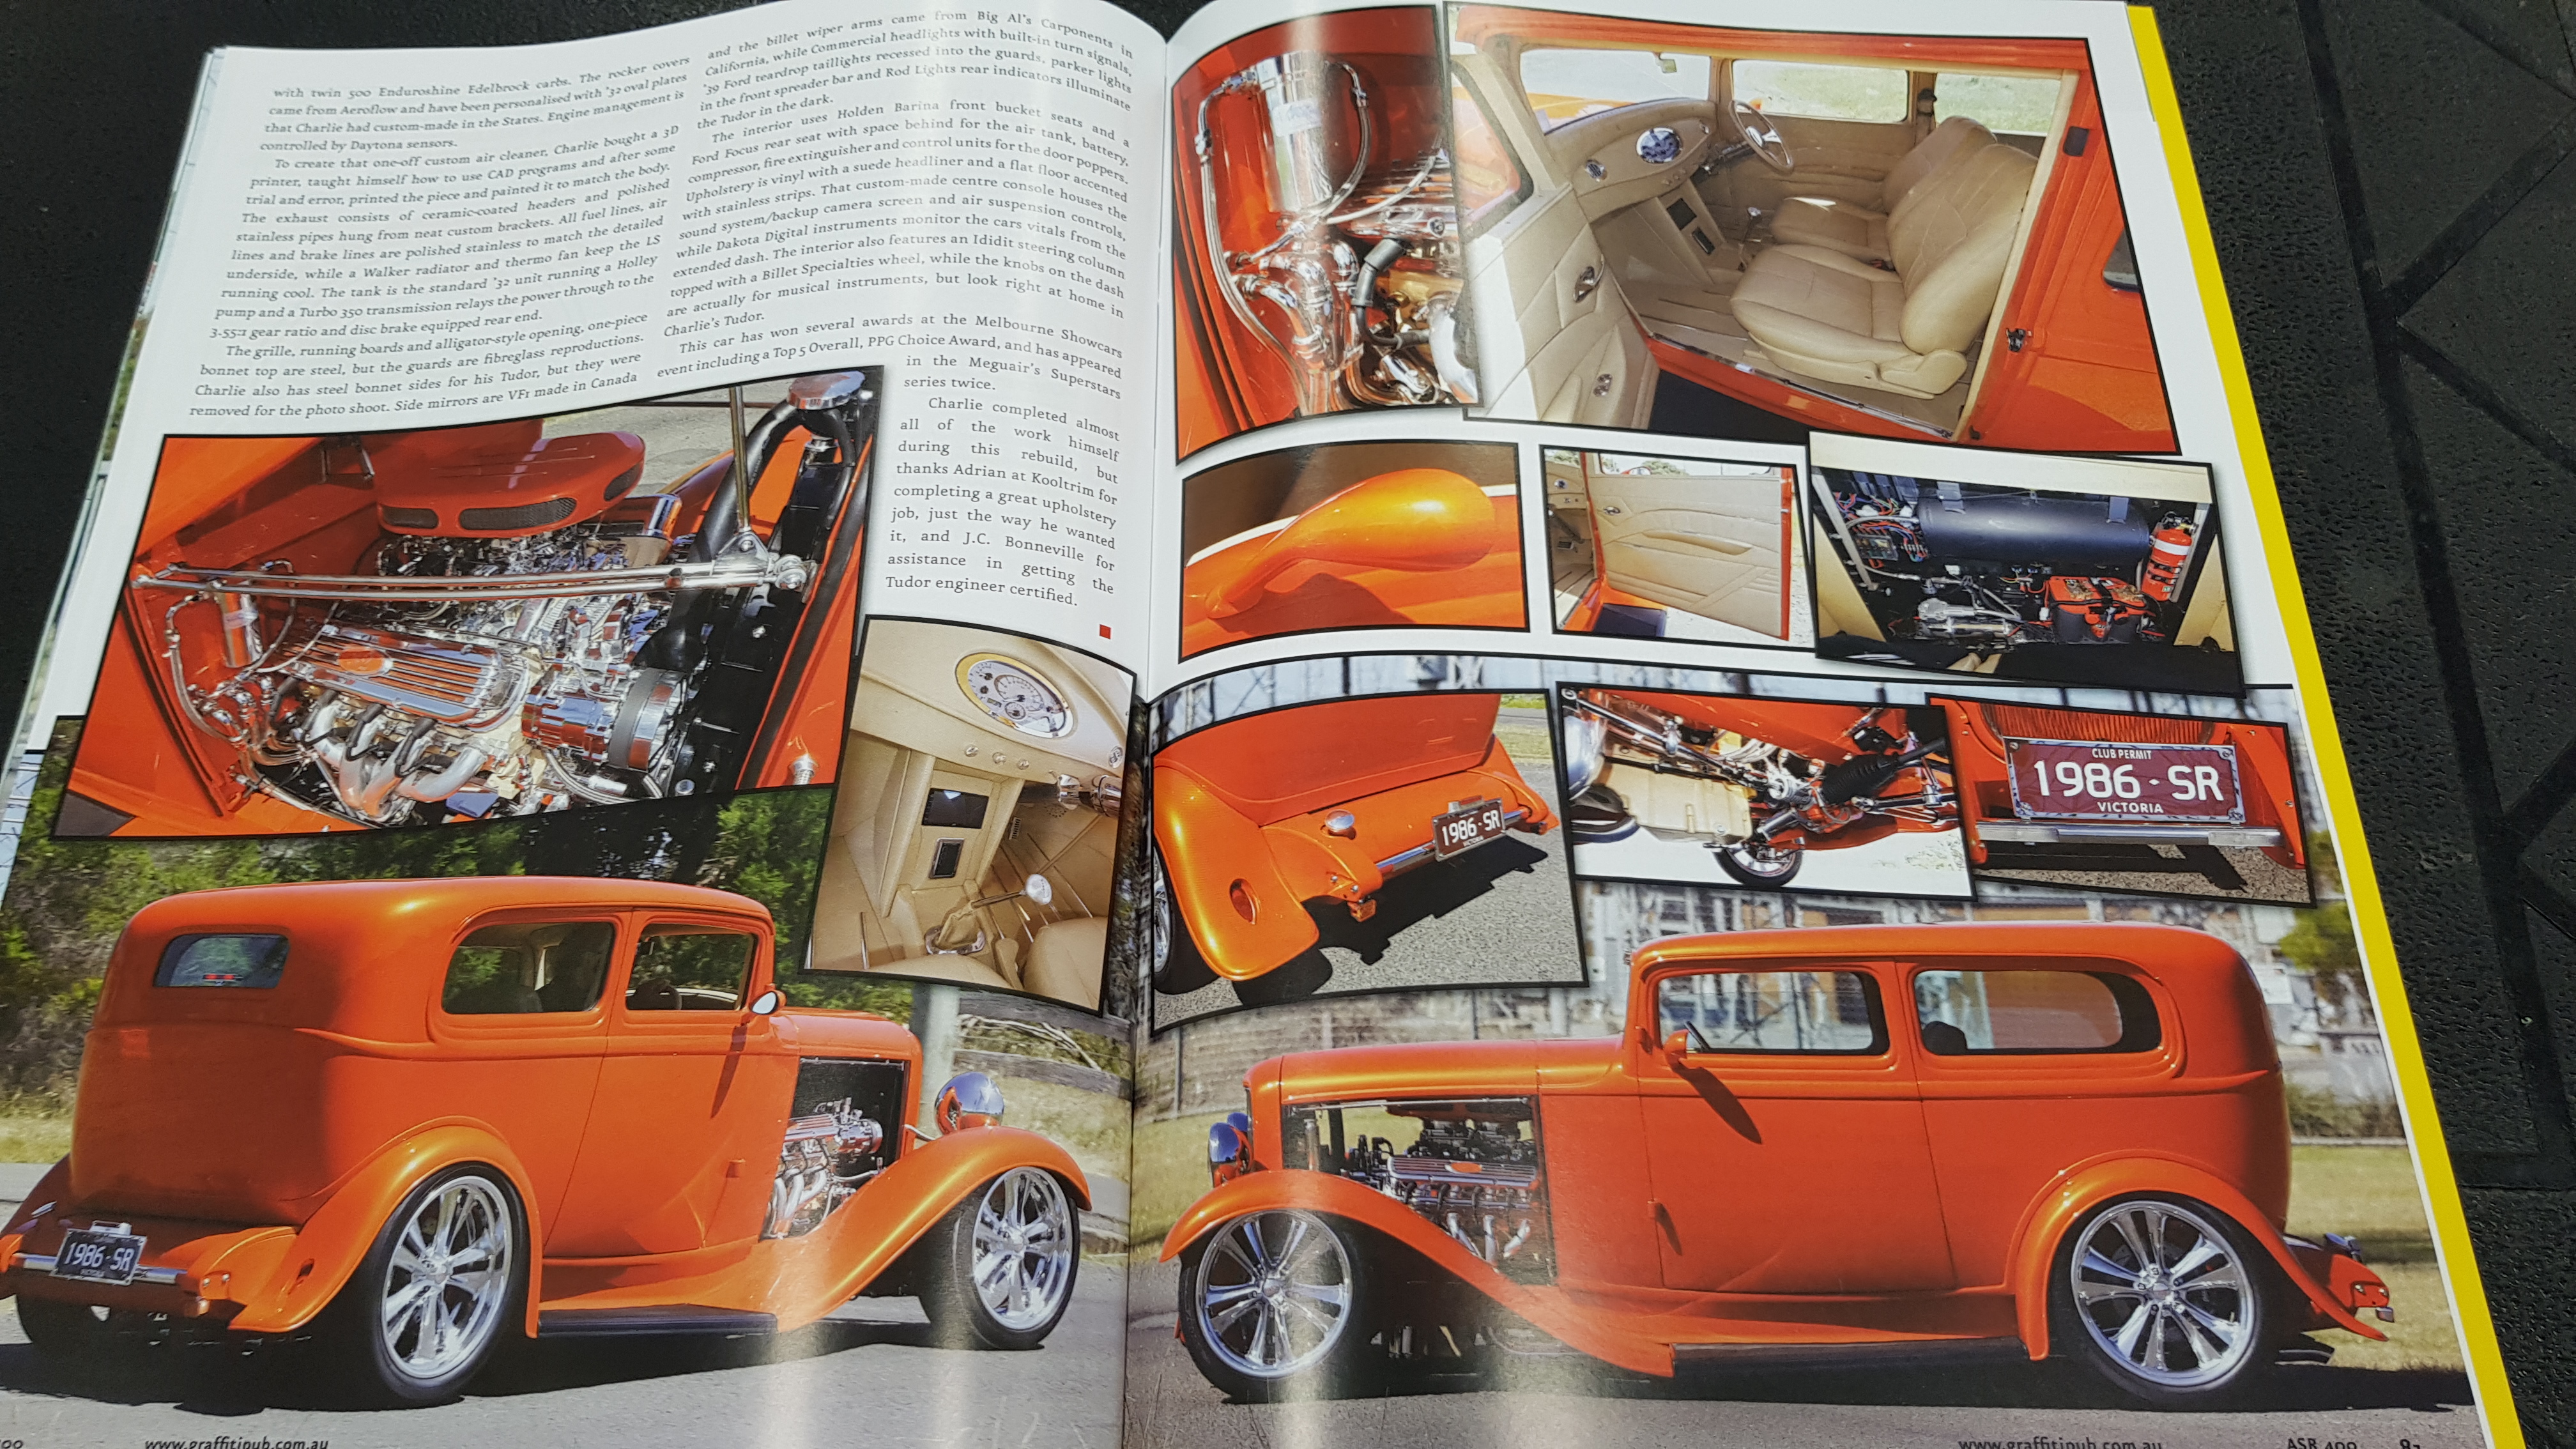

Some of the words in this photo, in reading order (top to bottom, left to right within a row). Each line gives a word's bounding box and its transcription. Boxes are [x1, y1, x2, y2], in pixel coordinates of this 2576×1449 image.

[697, 118, 717, 129] the
[720, 111, 756, 124] Tudor
[760, 106, 772, 116] in
[776, 101, 797, 112] the
[799, 93, 834, 108] dark.
[241, 213, 266, 223] The
[275, 213, 328, 224] exhaust
[337, 212, 390, 223] consists
[399, 210, 415, 221] of
[422, 202, 518, 220] ceramic-coated
[527, 197, 576, 211] headers
[584, 189, 609, 203] and
[617, 178, 670, 201] polished
[305, 268, 343, 279] while
[364, 266, 411, 277] Walker
[415, 264, 470, 275] radiator
[474, 258, 500, 271] and
[505, 255, 553, 268] thermo
[557, 250, 578, 261] fan
[585, 245, 614, 257] keep
[620, 240, 640, 251] the
[646, 234, 661, 246] LS
[676, 243, 712, 259] while
[716, 236, 760, 251] Dakota
[765, 224, 808, 243] Digital
[813, 218, 897, 234] instruments
[903, 213, 961, 224] monitor
[965, 213, 989, 226] the
[993, 218, 1022, 229] cars
[1027, 222, 1065, 238] vitals
[1070, 229, 1102, 250] from
[1106, 244, 1126, 260] the
[666, 307, 687, 317] are
[693, 294, 746, 312] actually
[751, 290, 772, 302] for
[778, 280, 830, 298] musical
[837, 275, 928, 289] instruments,
[935, 272, 960, 284] but
[967, 273, 998, 286] look
[1006, 278, 1041, 293] right
[1048, 288, 1062, 298] at
[1068, 289, 1105, 310] home
[1110, 304, 1124, 319] in
[670, 279, 713, 299] topped
[716, 273, 747, 288] with
[762, 266, 798, 280] Billet
[801, 257, 875, 277] Specialties
[878, 252, 925, 265] wheel,
[929, 252, 970, 264] while
[975, 254, 999, 266] the
[1003, 256, 1045, 273] knobs
[1048, 268, 1066, 279] on
[1070, 271, 1092, 286] the
[1095, 279, 1124, 299] dash
[679, 340, 707, 354] This
[713, 337, 735, 348] car
[740, 332, 763, 343] has
[769, 327, 799, 338] won
[805, 317, 855, 334] several
[862, 313, 913, 327] awards
[921, 316, 935, 324] at
[943, 313, 967, 325] the
[975, 315, 1054, 337] Melbourne
[1061, 329, 1123, 358] Showcars
[724, 311, 765, 326] Tudor.
[194, 384, 246, 396] Charlie
[252, 385, 280, 396] also
[286, 385, 310, 396] has
[316, 383, 349, 395] steel
[355, 382, 402, 394] bonnet
[408, 378, 442, 390] sides
[447, 376, 468, 387] for
[473, 373, 494, 385] his
[547, 365, 569, 376] but
[575, 360, 604, 372] they
[610, 354, 641, 365] were
[200, 364, 250, 376] bonnet
[255, 368, 278, 380] top
[282, 368, 306, 376] are
[352, 363, 375, 374] but
[380, 361, 402, 372] the
[405, 357, 452, 375] guards
[457, 358, 479, 367] are
[483, 349, 545, 365] fibreglass
[903, 376, 946, 387] series
[951, 378, 995, 390] twice.
[906, 355, 921, 366] in
[933, 355, 957, 367] the
[968, 356, 1041, 376] Meguair's
[1050, 368, 1121, 399] Superstars
[900, 418, 919, 430] all
[937, 418, 954, 431] of
[971, 420, 996, 433] the
[1013, 428, 1052, 442] work
[1068, 435, 1120, 463] himself
[928, 397, 983, 411] Charlie
[992, 404, 1067, 424] completed
[1076, 418, 1120, 441] almost
[896, 462, 949, 474] thanks
[953, 463, 1006, 479] Adrian
[1011, 471, 1027, 482] at
[1031, 471, 1094, 498] Kooltrim
[1098, 488, 1117, 505] for
[898, 440, 950, 457] during
[970, 442, 1000, 456] this
[1021, 450, 1078, 472] rebuild,
[1096, 465, 1119, 484] but
[890, 506, 919, 523] job,
[927, 507, 958, 523] just
[967, 509, 992, 522] the
[1000, 515, 1032, 530] way
[1039, 517, 1058, 532] he
[1066, 526, 1116, 550] wanted
[894, 484, 981, 503] completing
[985, 491, 993, 500] a
[997, 493, 1038, 506] great
[1042, 499, 1117, 530] upholstery
[890, 530, 906, 543] it,
[921, 530, 950, 542] and
[962, 532, 990, 545] J.C.
[1004, 535, 1084, 562] Bonneville
[1096, 555, 1115, 571] for
[885, 575, 931, 588] Tudor
[935, 578, 1006, 594] engineer
[1009, 585, 1078, 606] certified.
[887, 552, 967, 566] assistance
[986, 556, 1002, 569] in
[1021, 564, 1075, 586] getting
[1092, 578, 1114, 594] the
[2092, 748, 2117, 758] CLUB
[2118, 749, 2152, 760] PERMIT
[2097, 801, 2164, 814] VICTORIA
[0, 1439, 24, 1449] 00
[1958, 1436, 2162, 1449] wwwraffitiubcomau
